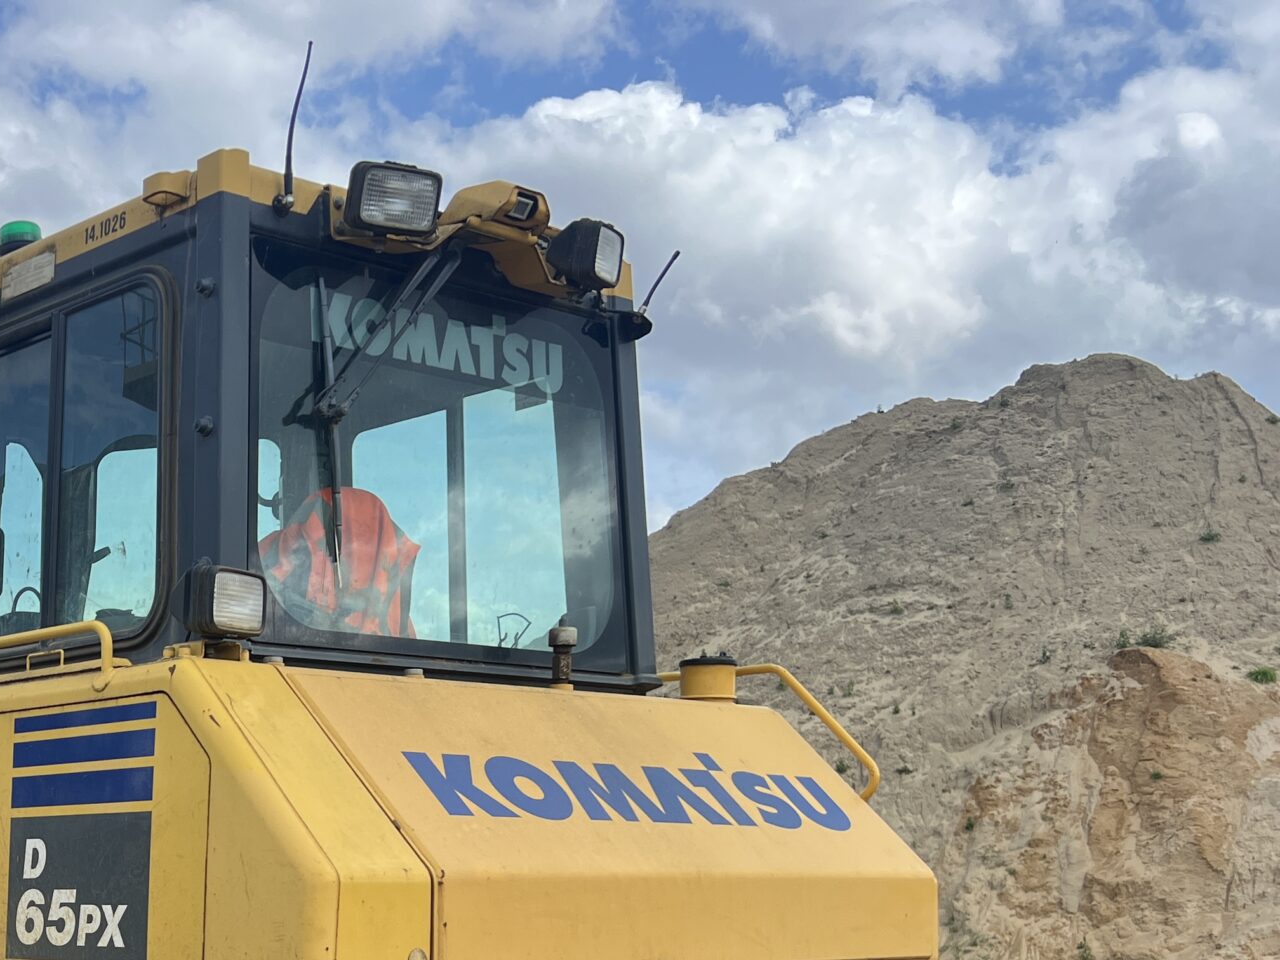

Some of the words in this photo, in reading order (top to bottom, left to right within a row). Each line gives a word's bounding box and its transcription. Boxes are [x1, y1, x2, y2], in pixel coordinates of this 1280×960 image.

[84, 211, 127, 245] 14.1026
[310, 287, 563, 394] KOMATSU
[401, 751, 851, 832] KOMATSU
[23, 838, 47, 879] D
[15, 888, 128, 948] 65PX
